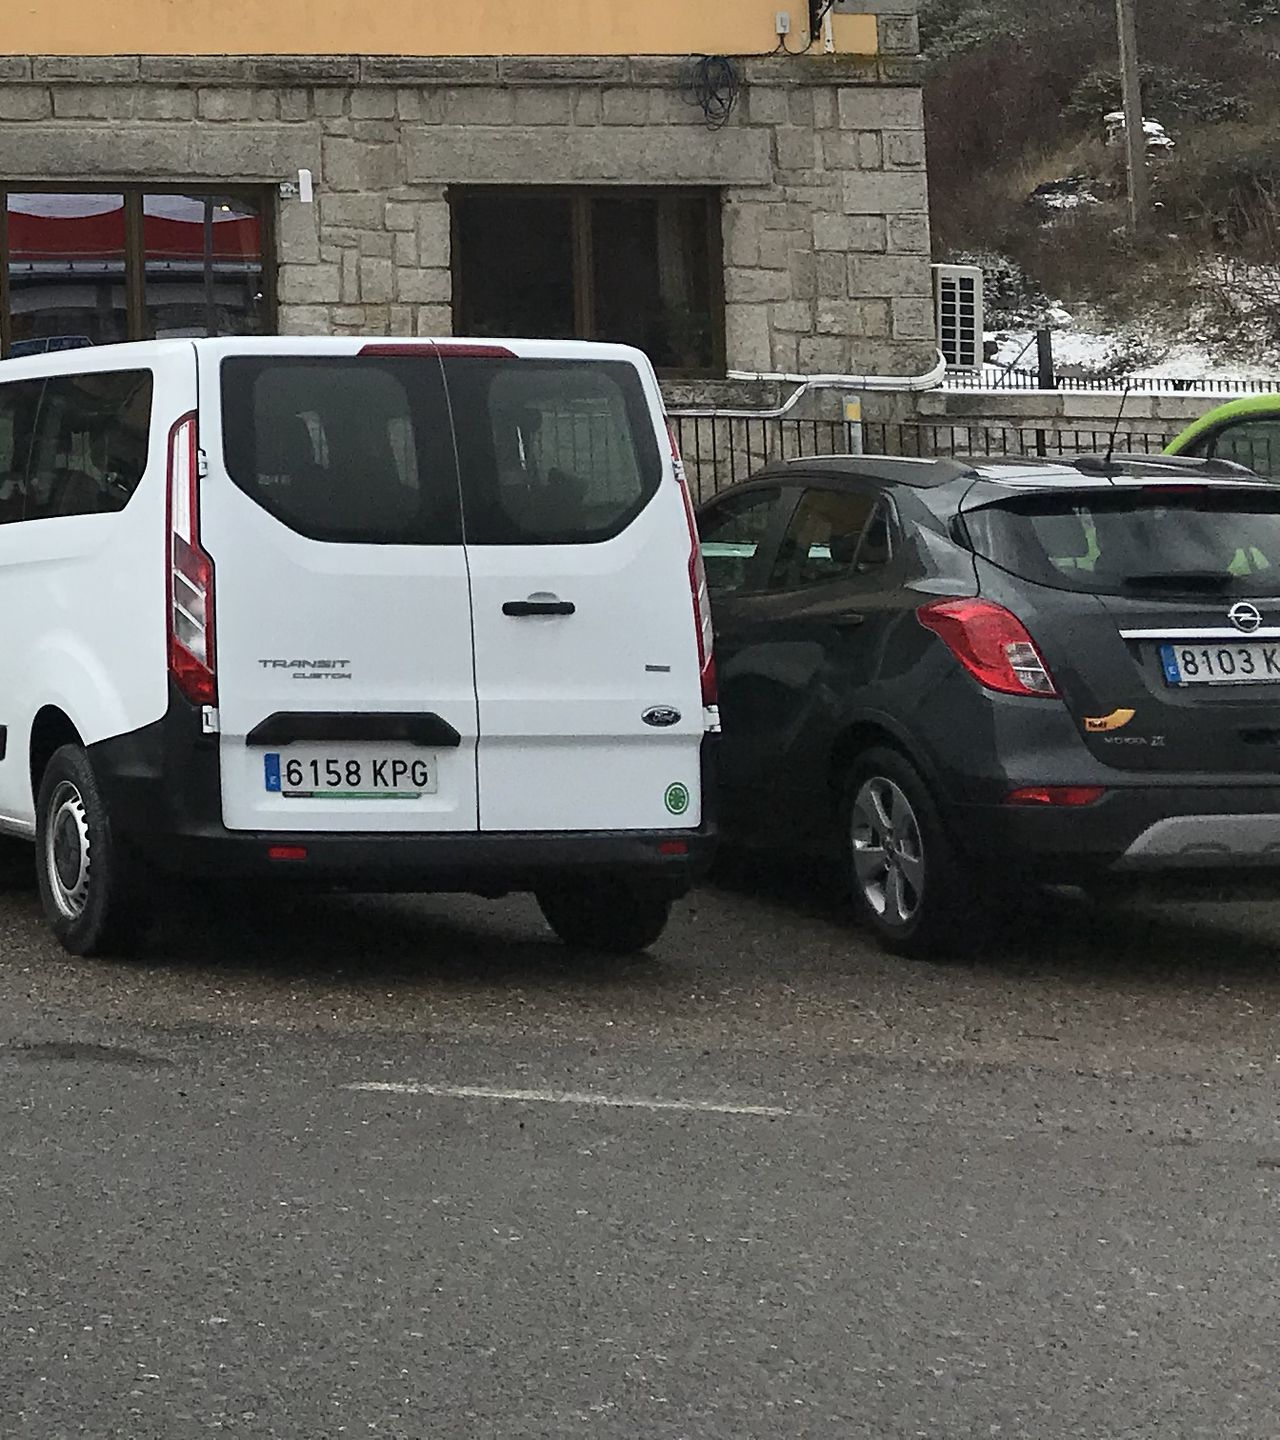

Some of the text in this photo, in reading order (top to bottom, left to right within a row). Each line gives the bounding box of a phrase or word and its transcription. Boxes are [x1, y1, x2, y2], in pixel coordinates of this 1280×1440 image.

[258, 659, 351, 669] TRANSIT
[1181, 648, 1256, 676] 8103
[292, 672, 352, 680] CUSTOM
[285, 758, 429, 788] 6158 KPG
